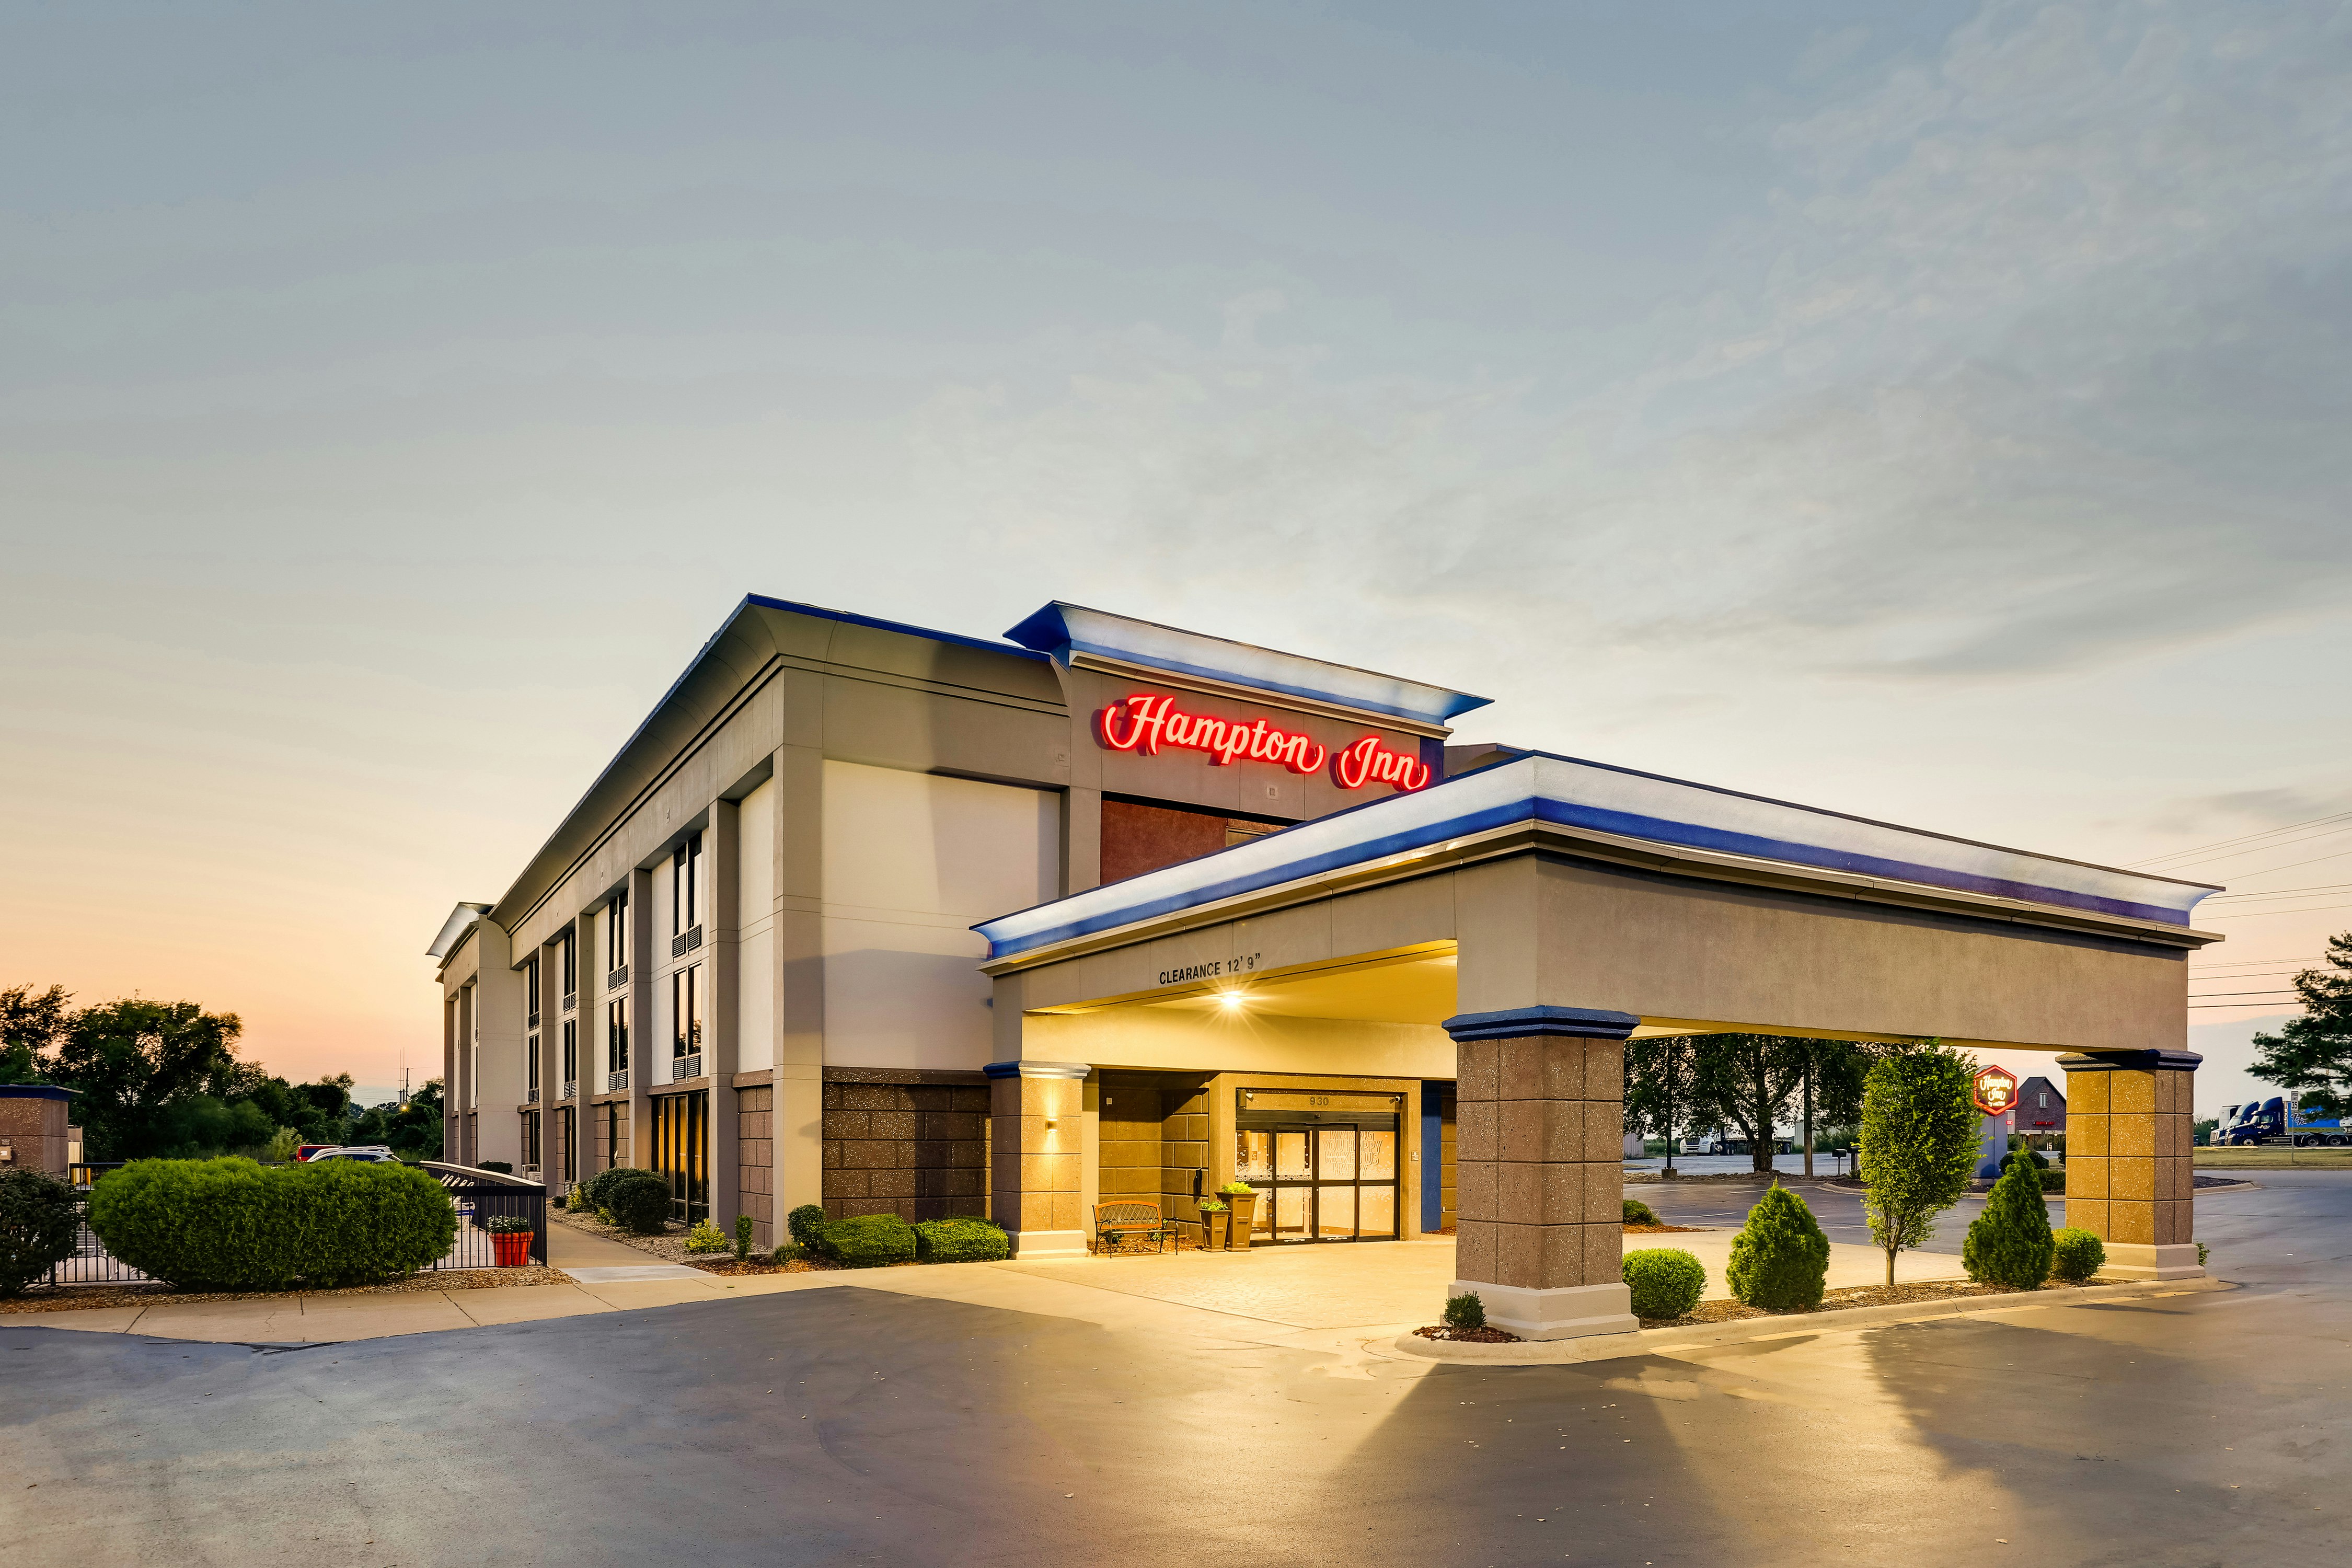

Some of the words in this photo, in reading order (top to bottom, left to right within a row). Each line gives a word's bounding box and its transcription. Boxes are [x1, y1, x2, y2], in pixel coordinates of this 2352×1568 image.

[1104, 696, 1324, 773] Hampton
[1340, 737, 1428, 790] Inn
[1159, 962, 1220, 985] CLEARANCE
[1980, 1075, 2013, 1091] Hampton
[1988, 1087, 2006, 1101] Inn
[1310, 1097, 1329, 1106] 930
[1330, 1131, 1375, 1140] MAKNG
[1322, 1139, 1344, 1151] YOU
[1346, 1139, 1382, 1153] HPPY
[1324, 1151, 1362, 1164] MAKE
[1366, 1152, 1379, 1166] US
[1333, 1163, 1368, 1177] HAPY
